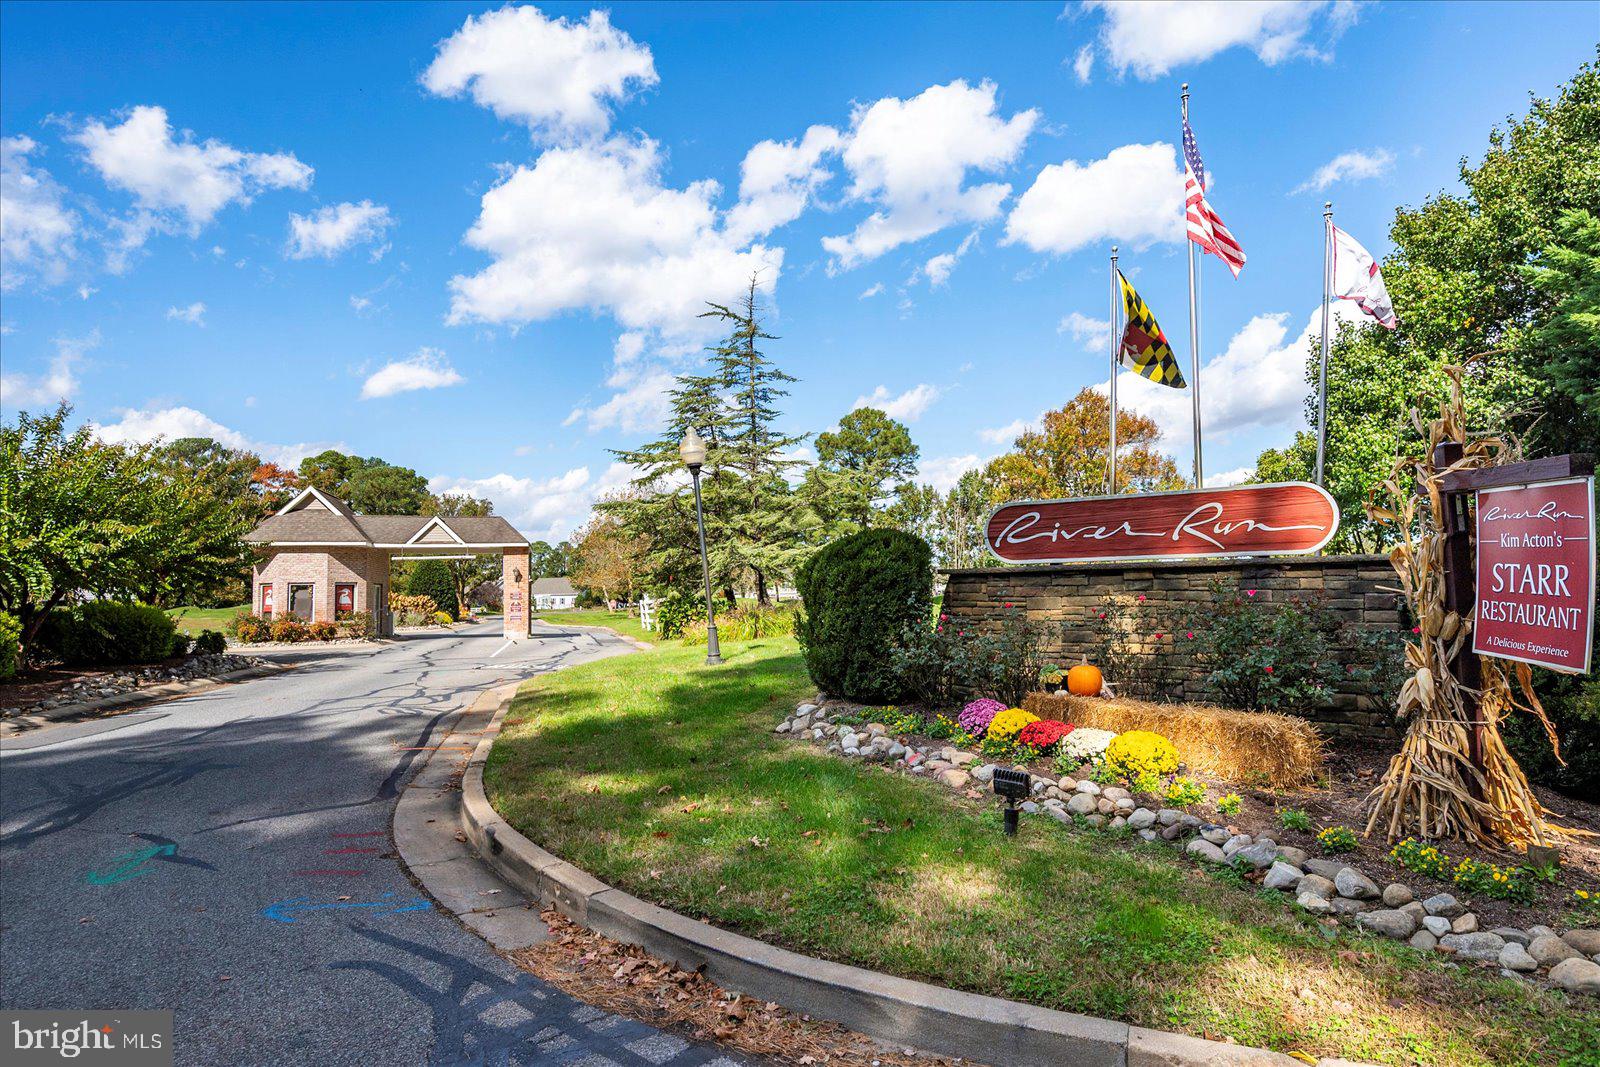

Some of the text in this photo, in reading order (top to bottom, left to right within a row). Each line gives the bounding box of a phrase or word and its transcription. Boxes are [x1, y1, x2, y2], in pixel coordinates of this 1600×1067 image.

[995, 502, 1326, 549] River Run
[1500, 531, 1563, 548] Kim Acton's
[1492, 563, 1571, 597] STARR
[1481, 599, 1581, 631] RESTAURANT
[1486, 636, 1570, 658] A Delicious Experience
